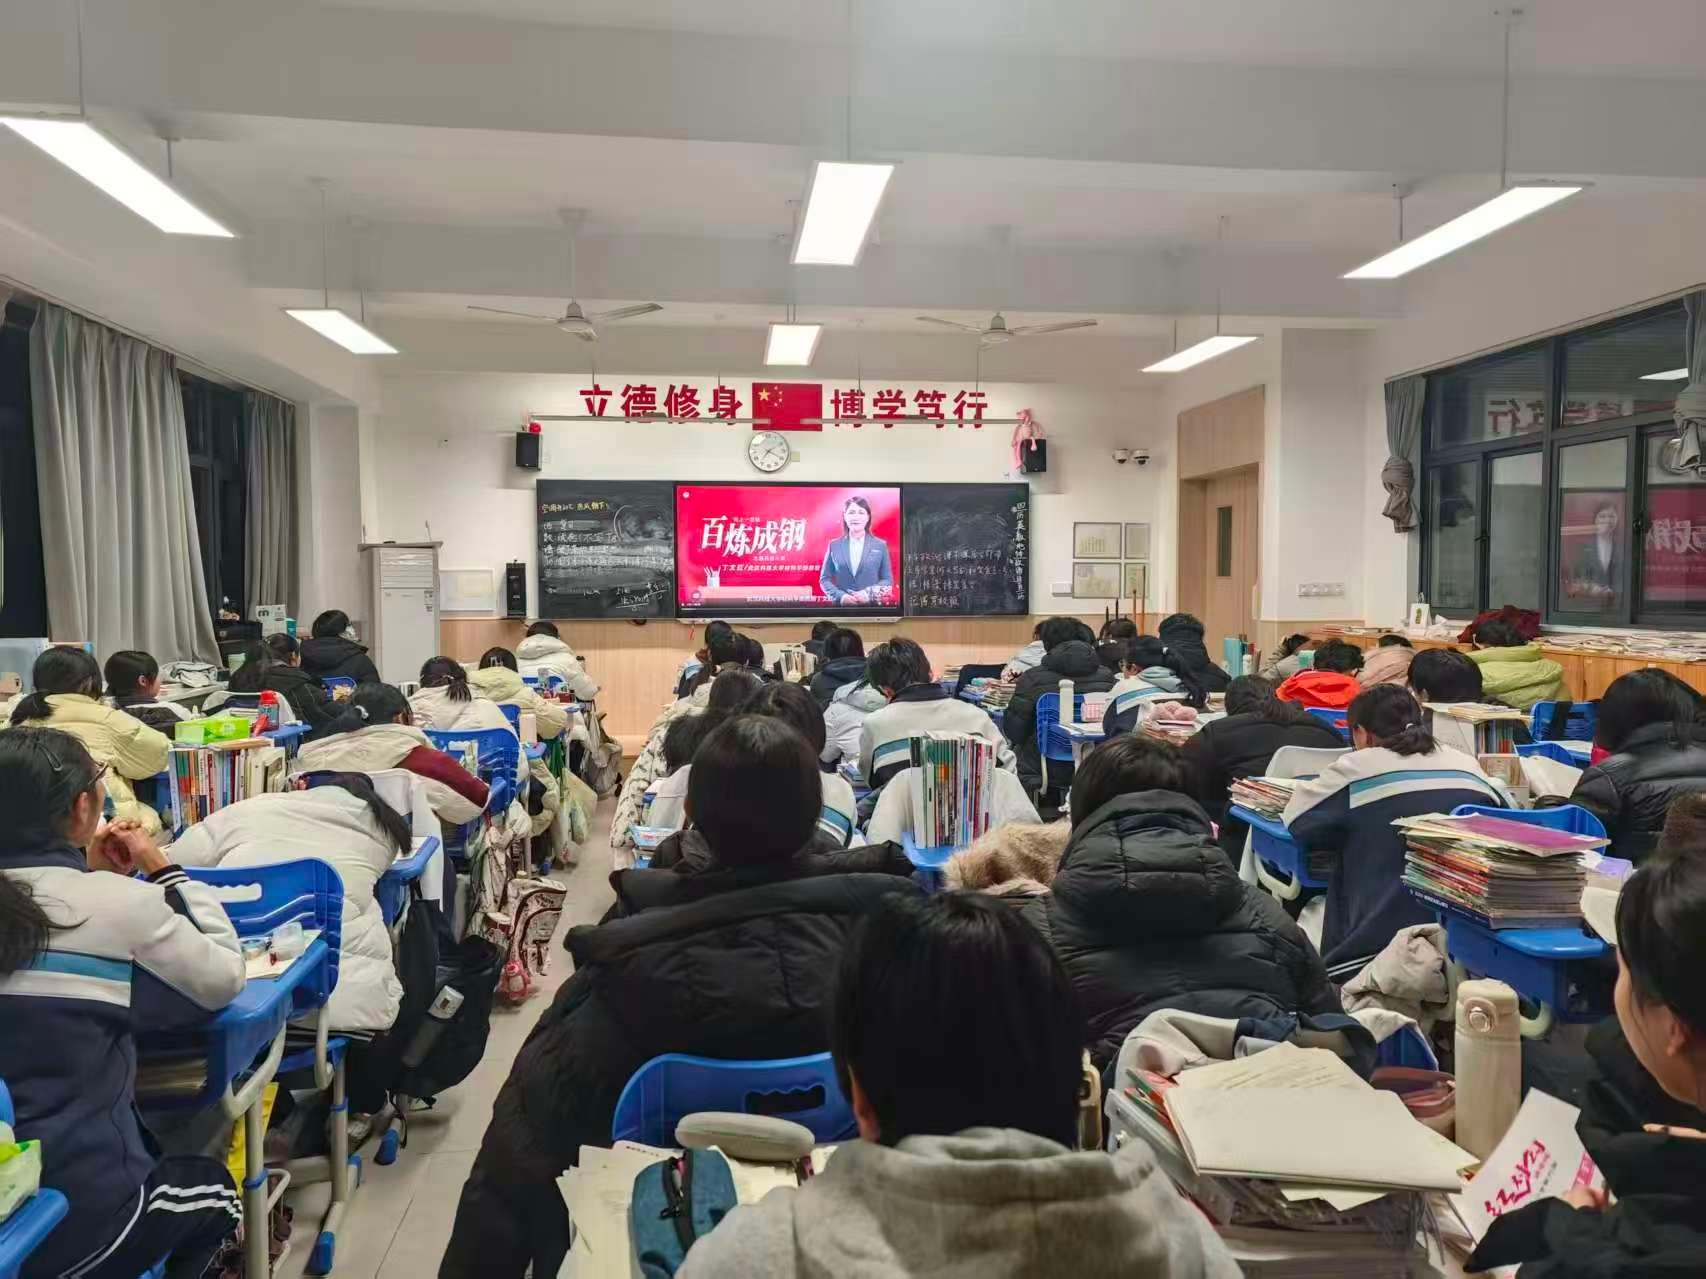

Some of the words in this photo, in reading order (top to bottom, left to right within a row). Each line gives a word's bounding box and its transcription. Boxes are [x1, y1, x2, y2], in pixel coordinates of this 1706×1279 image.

[579, 384, 743, 425] 立德修身
[830, 388, 988, 429] 博学笃行
[702, 515, 806, 557] 百炼成钢
